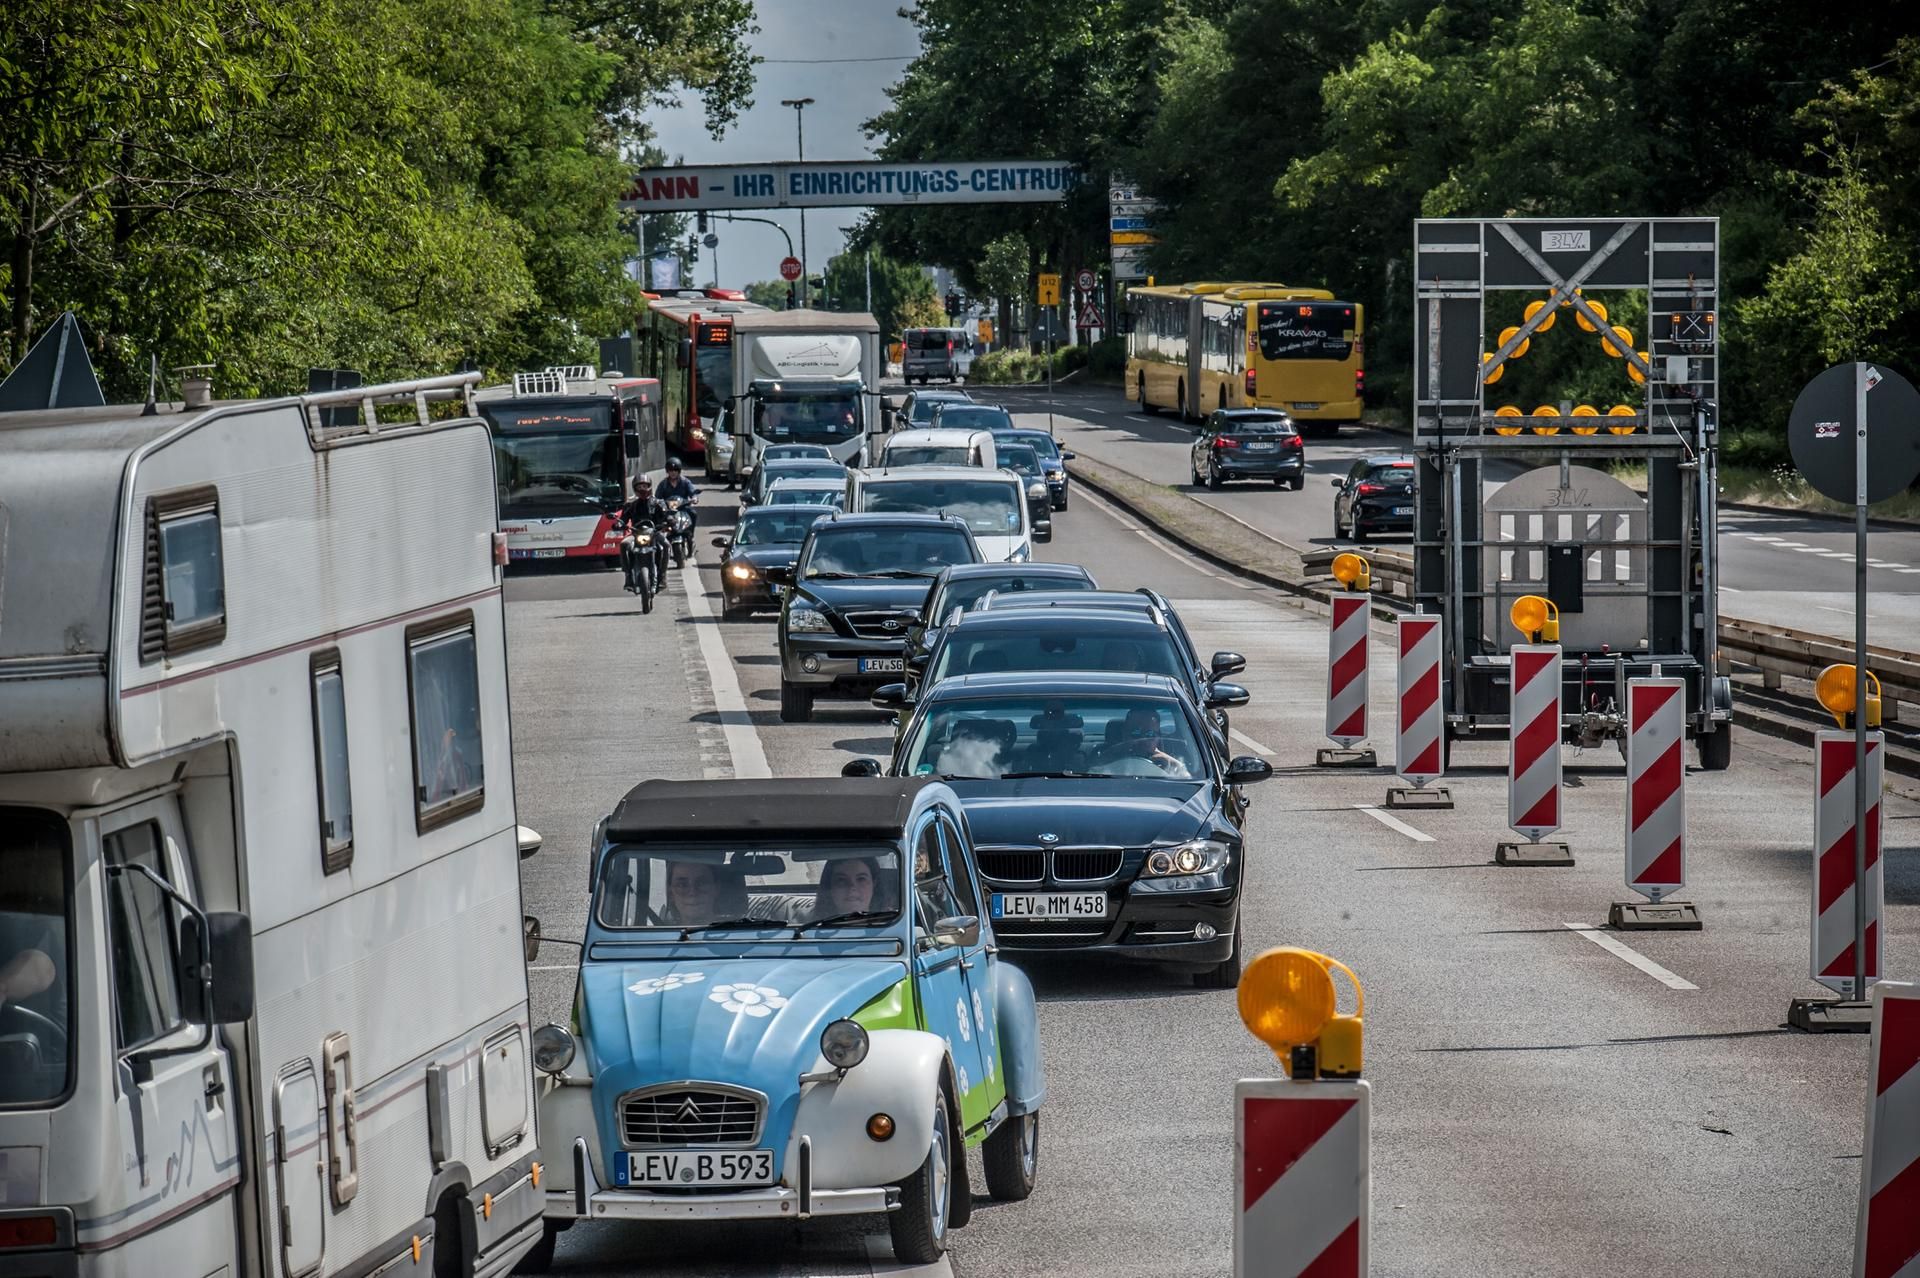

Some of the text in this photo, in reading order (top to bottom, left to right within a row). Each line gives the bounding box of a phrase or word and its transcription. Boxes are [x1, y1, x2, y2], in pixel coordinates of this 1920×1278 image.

[734, 174, 775, 197] IHR
[782, 263, 801, 275] STOP
[1041, 278, 1057, 286] U12
[1081, 276, 1092, 287] 50
[1278, 328, 1327, 338] KRAVAG
[865, 657, 903, 671] LEV SG
[1004, 896, 1035, 915] LEV
[1048, 896, 1069, 914] MM
[1073, 896, 1104, 914] 458
[630, 1155, 678, 1181] LEV
[697, 1155, 714, 1181] B
[720, 1154, 770, 1180] 593
